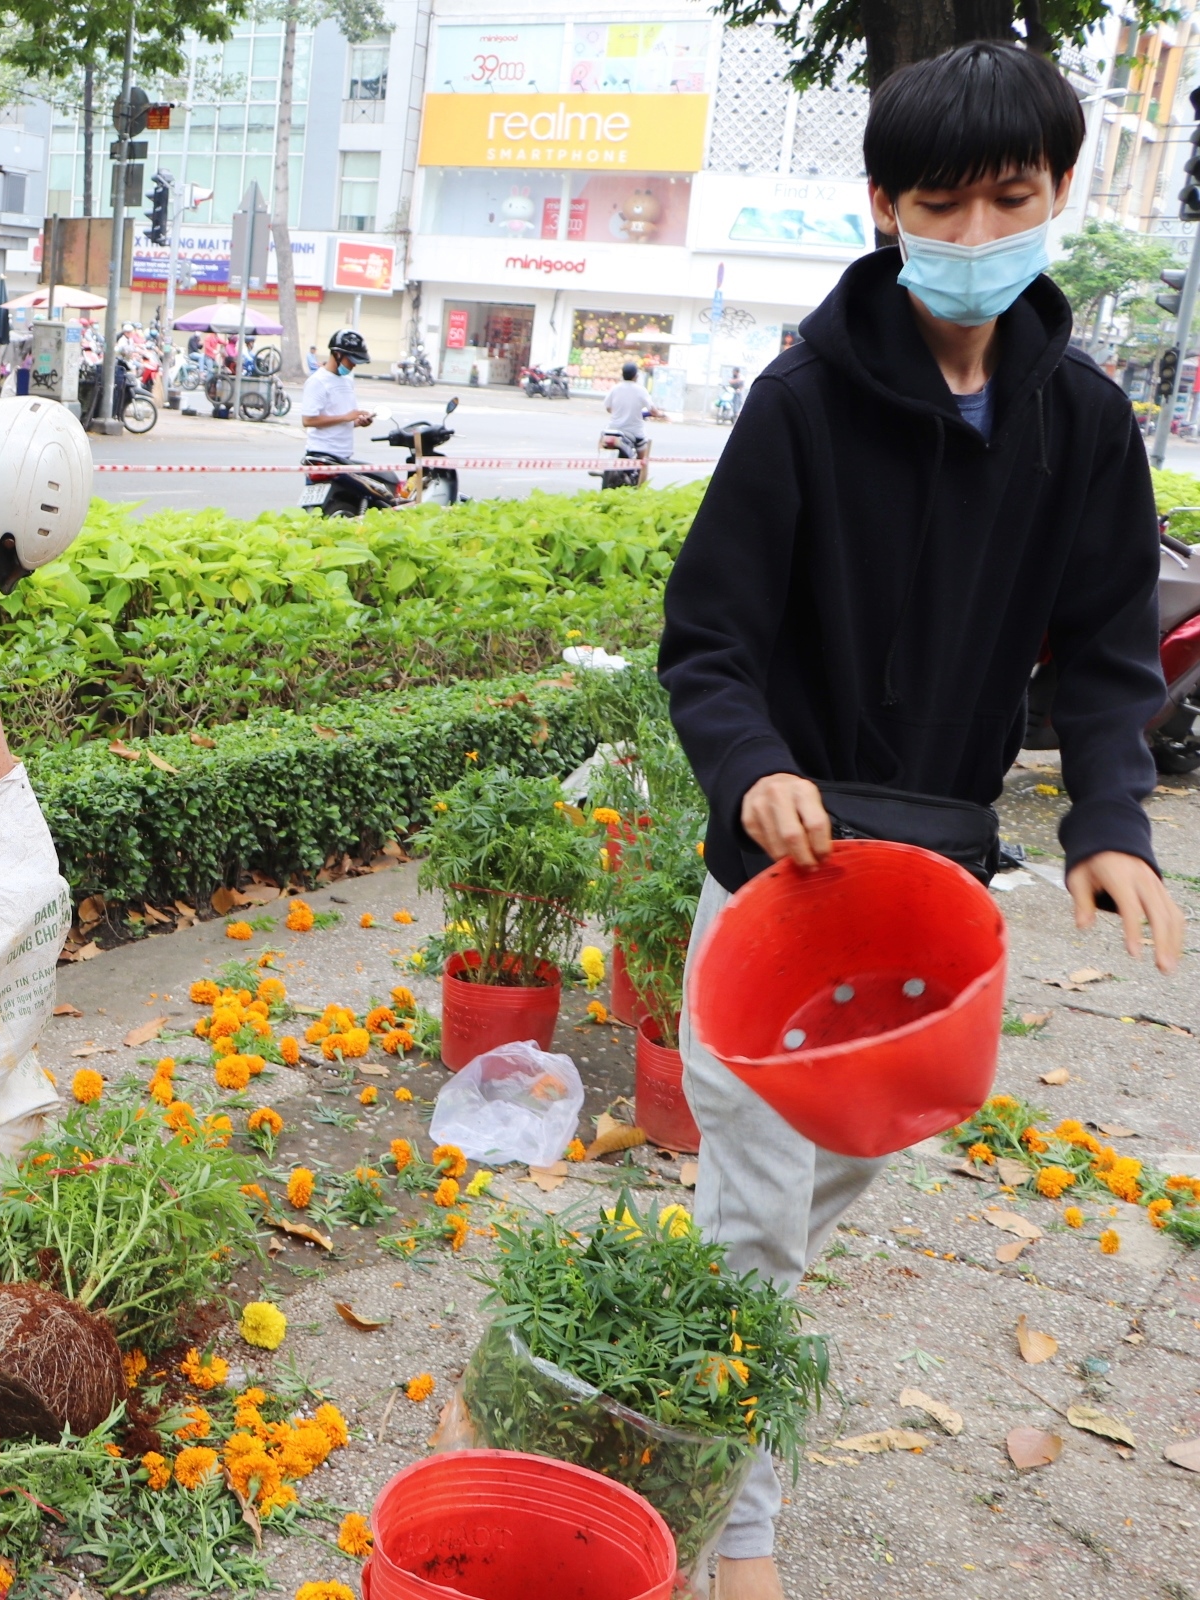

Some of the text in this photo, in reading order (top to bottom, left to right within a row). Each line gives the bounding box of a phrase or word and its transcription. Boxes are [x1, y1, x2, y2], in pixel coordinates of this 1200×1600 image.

[479, 33, 518, 43] minigood
[487, 101, 631, 142] realme
[486, 147, 629, 163] SMARTPHONE
[774, 183, 836, 201] Find X2
[505, 254, 586, 274] minigood
[35, 923, 58, 946] CHO
[15, 976, 30, 989] TIN
